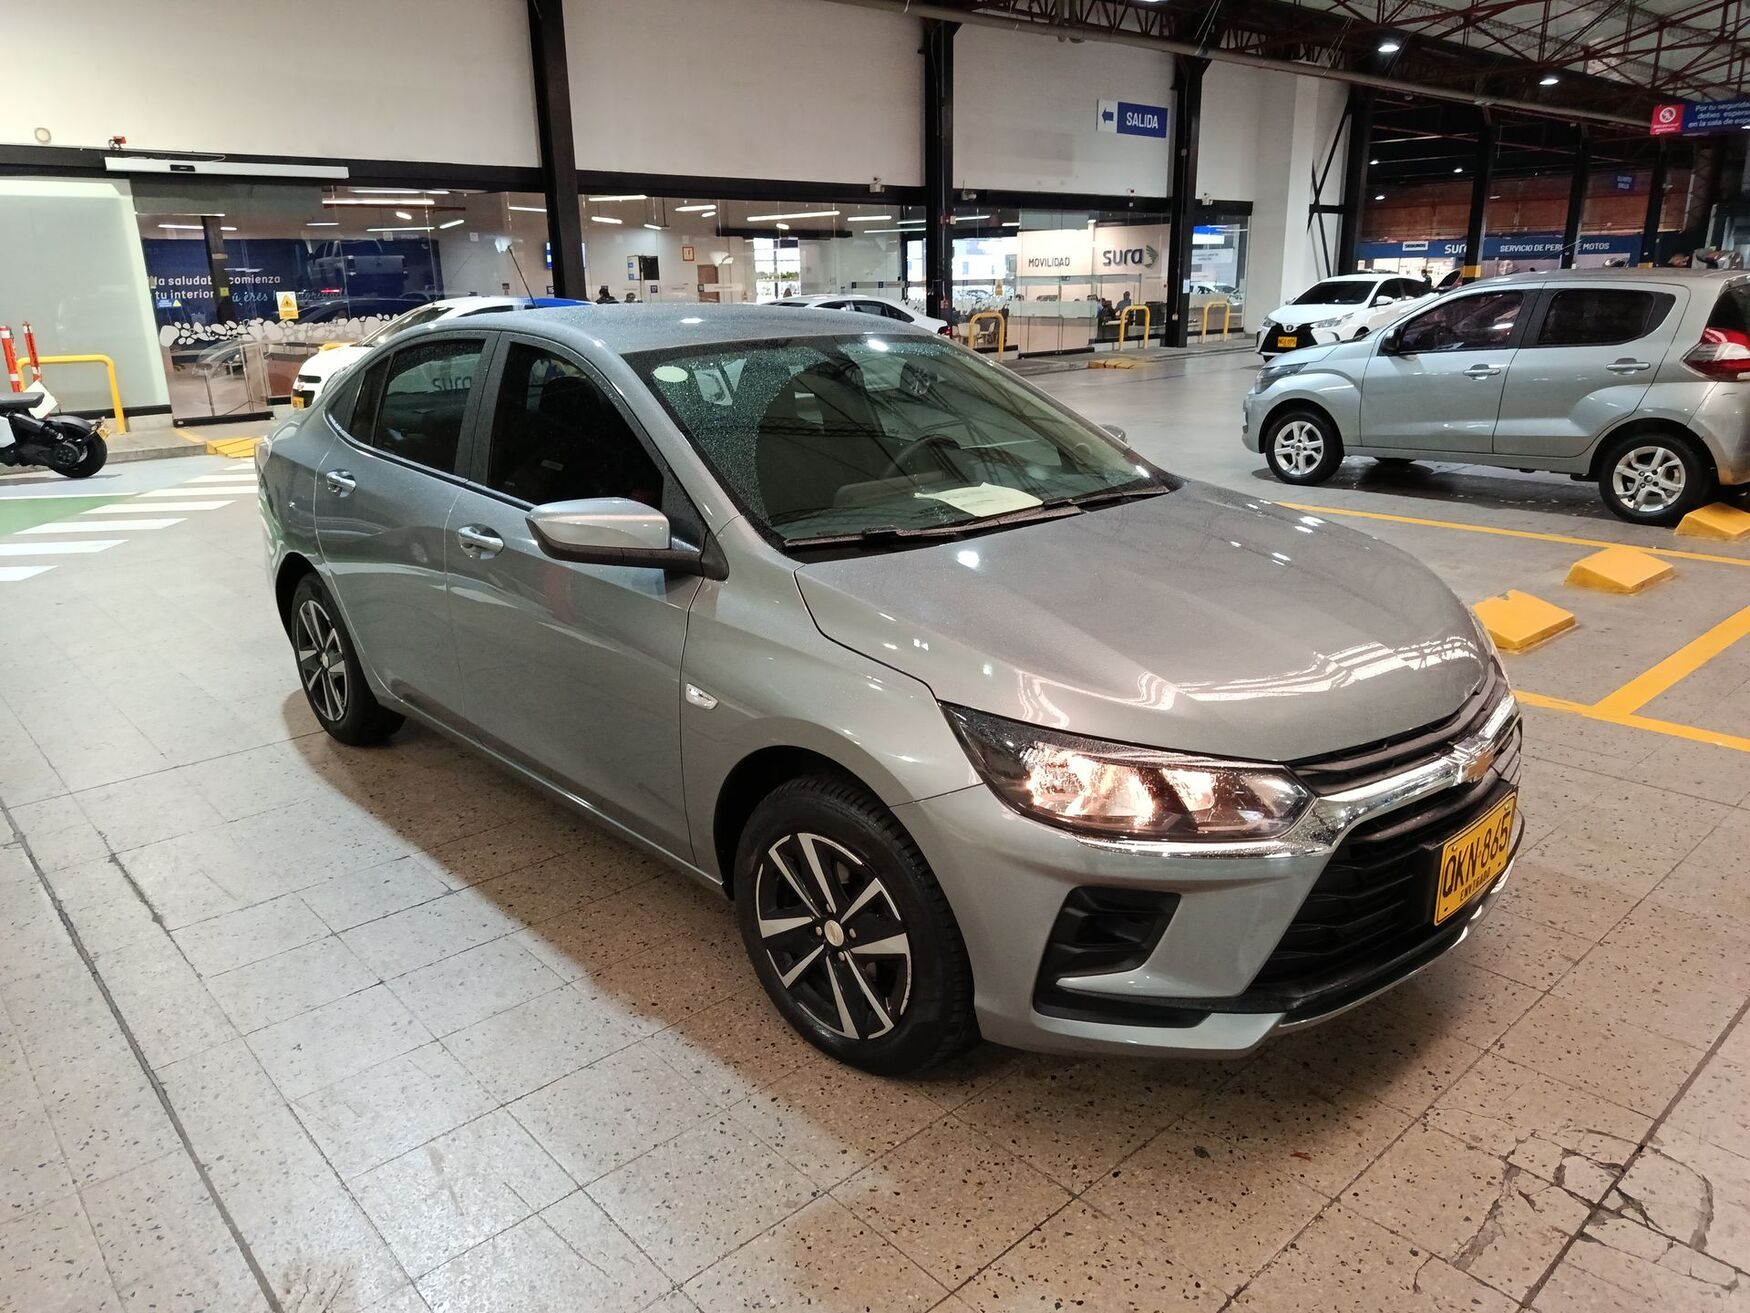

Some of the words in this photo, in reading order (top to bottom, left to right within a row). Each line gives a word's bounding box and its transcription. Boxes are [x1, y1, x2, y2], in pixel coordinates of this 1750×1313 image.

[1126, 112, 1158, 129] SALIDA
[1500, 244, 1533, 252] SERVICIO
[1533, 244, 1544, 252] DE
[1028, 257, 1071, 268] MOVILIDAD
[1103, 248, 1143, 267] sura
[155, 291, 168, 300] tu
[170, 289, 214, 299] interior
